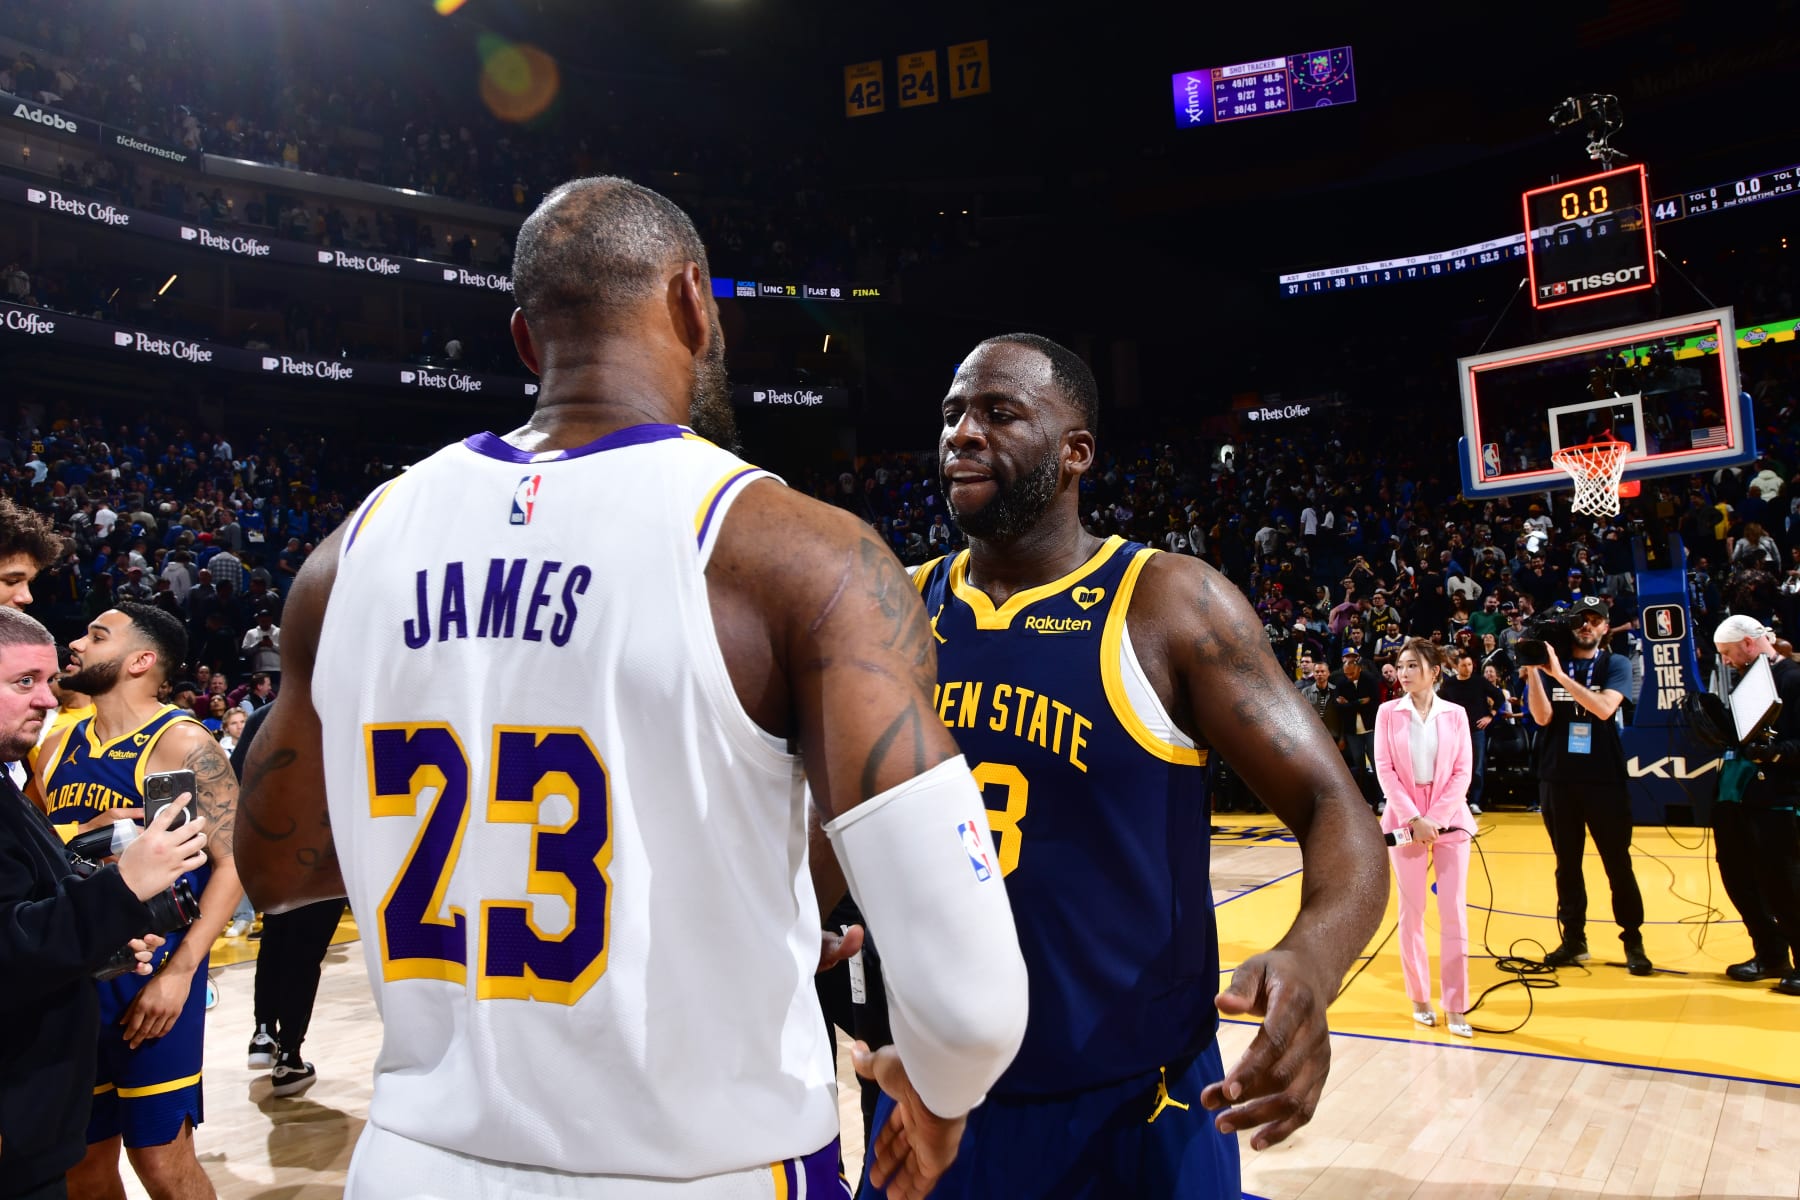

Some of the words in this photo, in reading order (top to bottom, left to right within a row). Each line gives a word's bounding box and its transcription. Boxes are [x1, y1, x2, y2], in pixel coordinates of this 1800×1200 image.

[957, 61, 982, 91] 17
[1229, 66, 1246, 75] SHOT
[1247, 60, 1276, 72] TRACKER
[849, 81, 881, 110] 42
[902, 71, 935, 101] 24
[1185, 76, 1203, 123] xfinity
[13, 103, 78, 134] Adobe
[116, 134, 188, 164] ticketmaster
[1773, 171, 1792, 181] TOL
[1689, 192, 1707, 202] TOL
[1709, 188, 1717, 198] 0
[1735, 177, 1761, 197] 0.0
[1738, 190, 1775, 204] OVERTIME
[1775, 183, 1792, 193] FLS
[1561, 186, 1608, 220] 0.0
[1690, 204, 1707, 214] FLS
[1711, 200, 1719, 209] 5
[87, 203, 130, 225] Coffee
[232, 237, 270, 256] Coffee
[366, 256, 401, 275] Coffee
[1288, 285, 1299, 295] 37
[1313, 281, 1321, 291] 11
[1335, 278, 1346, 288] 39
[1359, 275, 1368, 284] 11
[1384, 271, 1391, 281] 3
[1407, 267, 1417, 277] 17
[1431, 264, 1441, 274] 19
[1455, 259, 1467, 270] 54
[1480, 251, 1500, 264] 52.5
[1567, 266, 1645, 292] TISSOT
[763, 285, 783, 294] UNC
[785, 285, 796, 296] 75
[808, 287, 828, 296] FLAST
[830, 288, 841, 298] 68
[852, 289, 880, 297] FINAL
[7, 310, 55, 335] Coffee
[172, 341, 212, 363] Coffee
[315, 361, 353, 381] Coffee
[448, 376, 482, 393] Coffee
[793, 390, 823, 407] Coffee
[1283, 404, 1310, 419] Coffee
[403, 558, 592, 649] JAMES
[1024, 615, 1092, 631] Rakuten
[1652, 644, 1681, 665] GET
[1654, 666, 1684, 688] THE
[988, 683, 1093, 774] STATE
[363, 720, 614, 1006] 23
